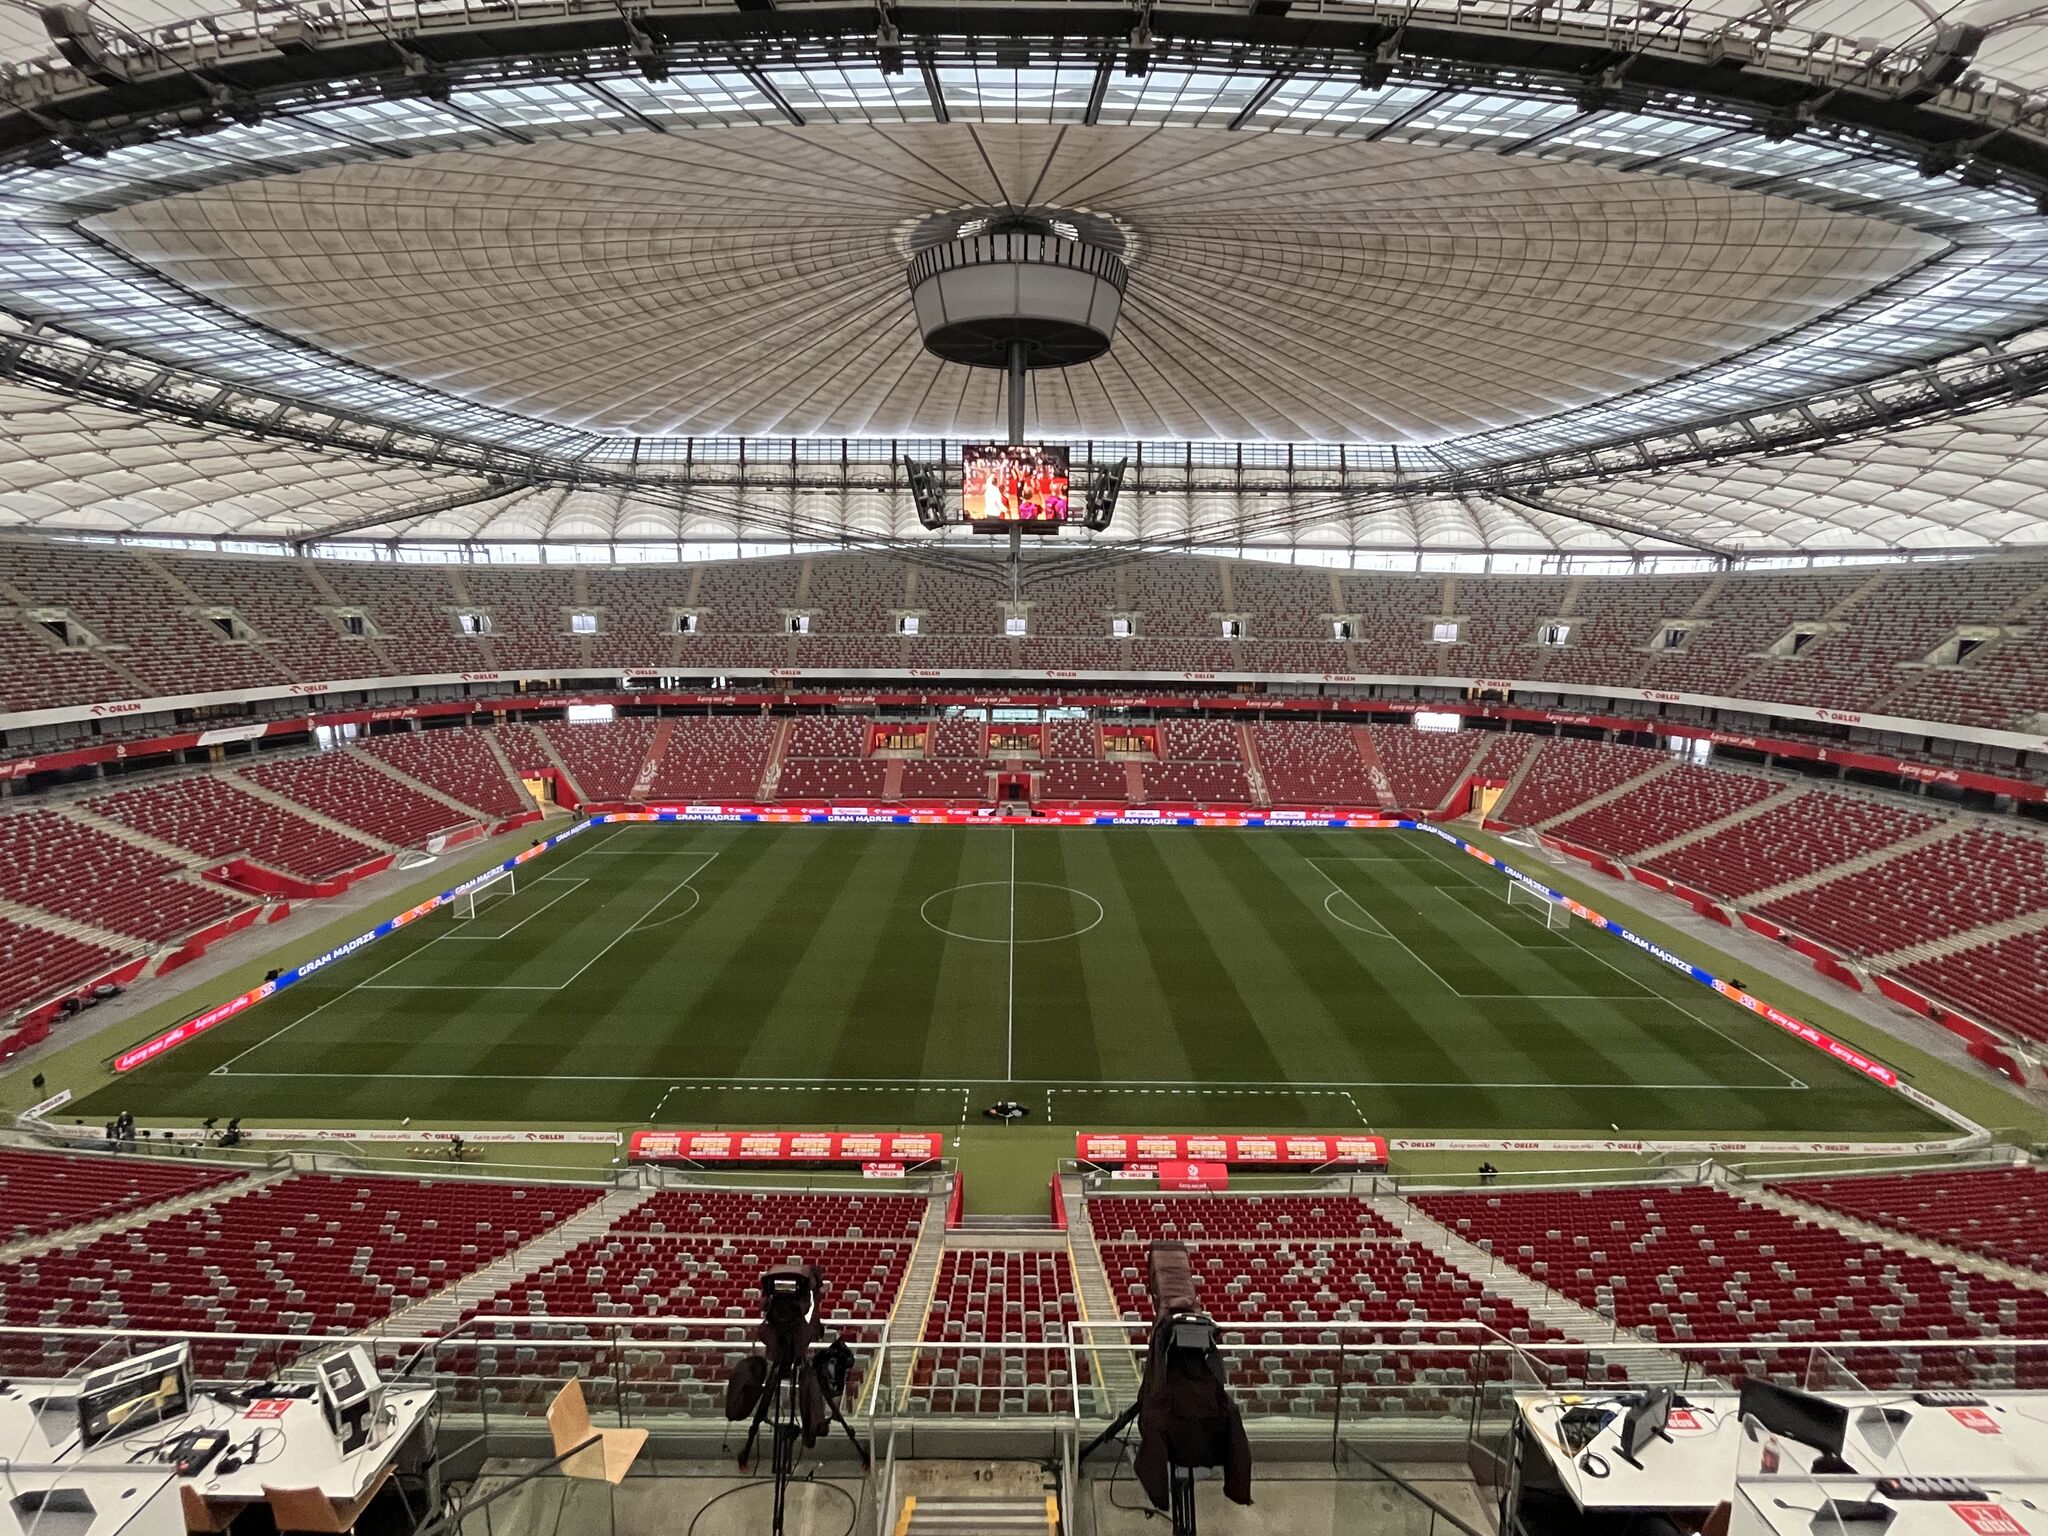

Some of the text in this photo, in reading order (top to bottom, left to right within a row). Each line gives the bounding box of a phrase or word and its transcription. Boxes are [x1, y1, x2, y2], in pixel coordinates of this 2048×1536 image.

[303, 684, 328, 693] ORLEN
[109, 703, 141, 713] ORLEN
[1831, 713, 1860, 723] ORLEN
[703, 814, 740, 822] MĄDRZE
[855, 815, 893, 823] MĄDRZE
[1504, 866, 1523, 880] GRAM
[455, 879, 476, 894] GRAM
[298, 930, 376, 977] GRAM MĄDRZE
[1622, 929, 1693, 973] GRAM MĄDRZE
[974, 1469, 993, 1482] 10
